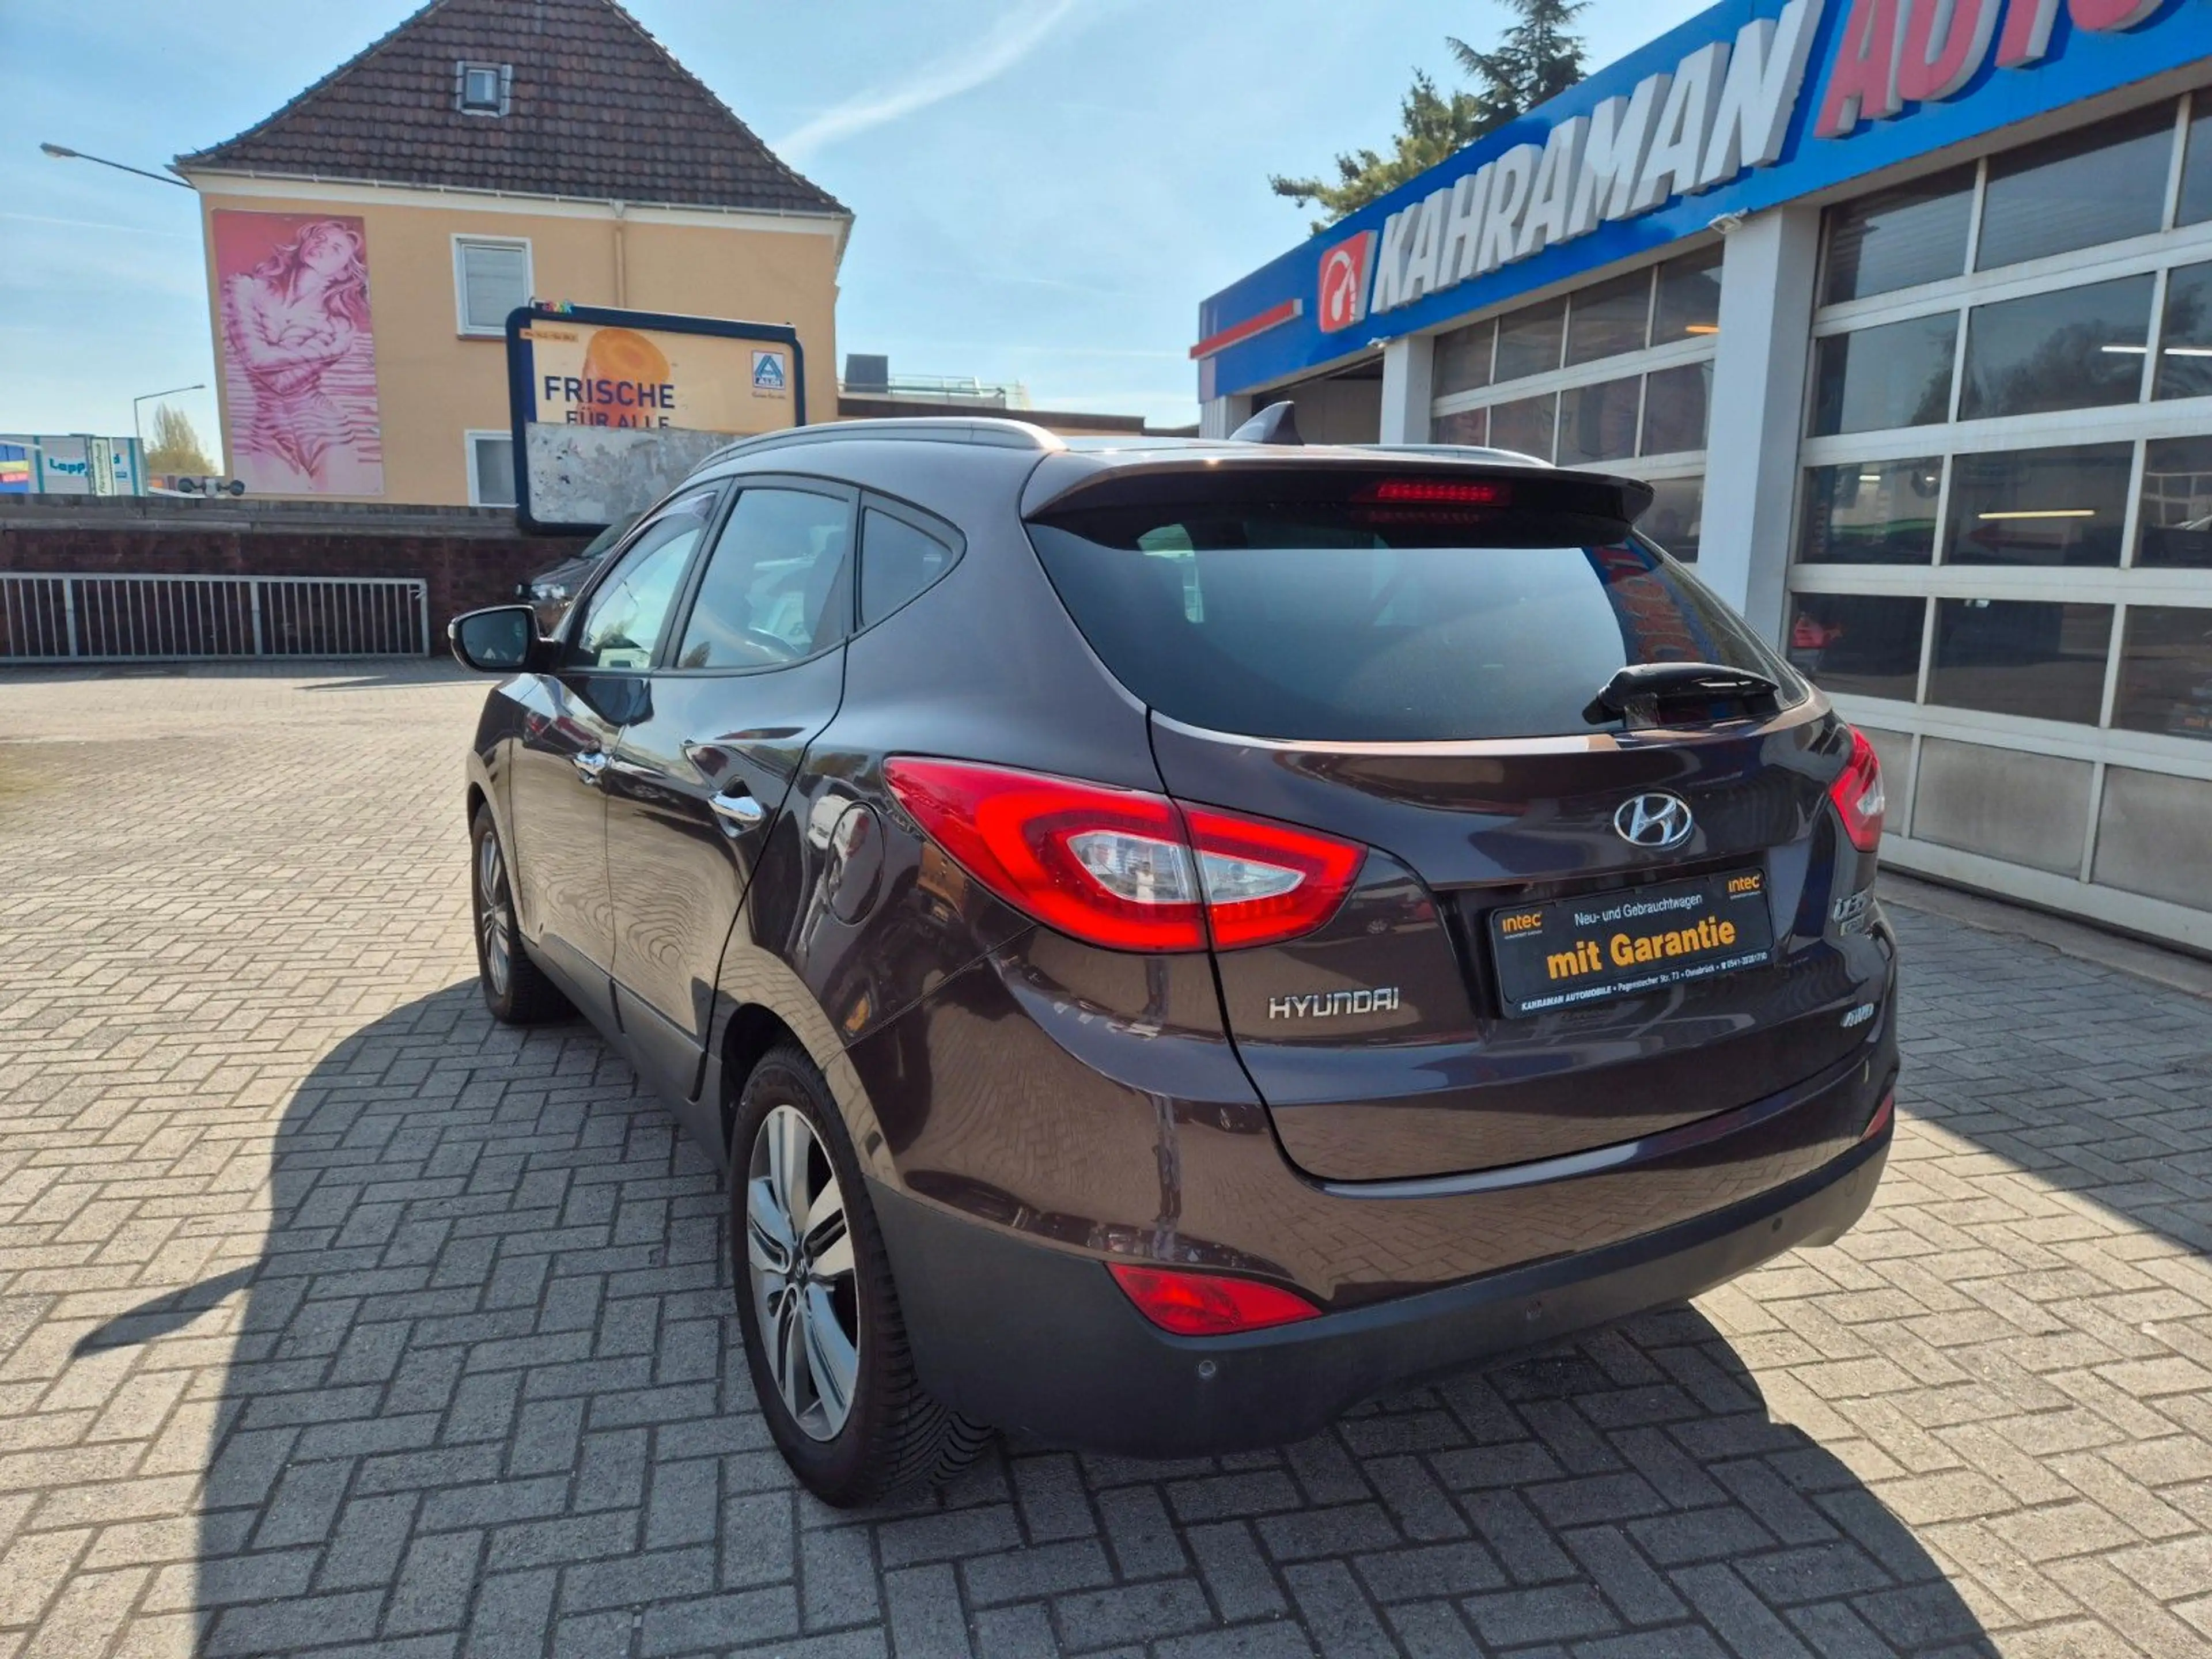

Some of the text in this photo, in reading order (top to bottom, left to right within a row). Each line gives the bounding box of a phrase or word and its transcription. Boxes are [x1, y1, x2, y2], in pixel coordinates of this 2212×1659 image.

[1370, 0, 2166, 315] KAHRAMAN AU
[544, 376, 675, 409] FRISCHE
[566, 407, 609, 426] FÜR
[1728, 876, 1760, 892] intec
[1502, 913, 1542, 933] intec
[1574, 894, 1703, 927] Neu- und Gebrauchtwagen
[1547, 915, 1736, 979] mit Garantie
[1268, 987, 1399, 1019] HYUNDAI
[1521, 995, 1564, 1011] KAHRAMAN
[1565, 986, 1612, 1002] AUTOMOBILE
